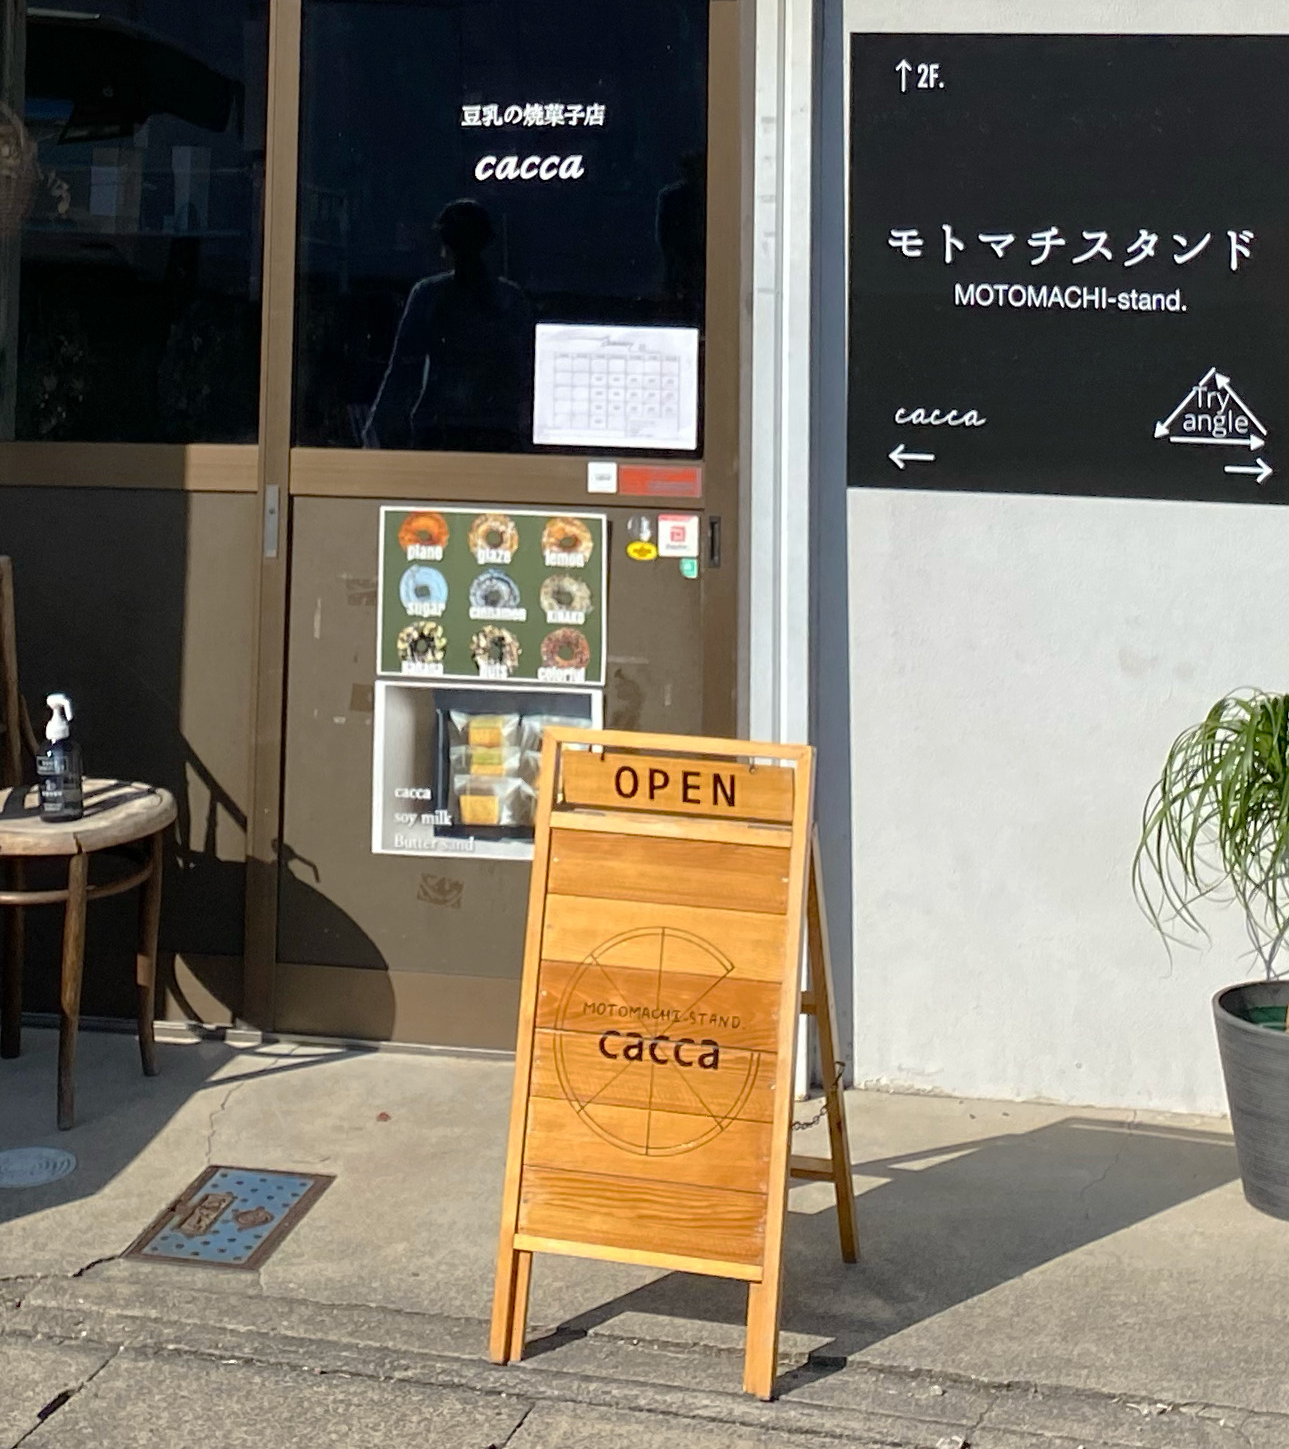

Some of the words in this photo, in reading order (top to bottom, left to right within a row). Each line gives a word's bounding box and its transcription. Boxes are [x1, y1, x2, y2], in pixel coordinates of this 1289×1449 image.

[461, 102, 607, 127] 豆乳の焼菓子店
[474, 154, 585, 181] cacca
[887, 223, 1255, 272] モトマチスタンド
[953, 283, 1188, 313] MOTOMACHI-stand.
[1192, 385, 1230, 414] Try
[894, 406, 987, 428] cacca
[1182, 407, 1250, 438] angle
[394, 787, 432, 800] cacca
[614, 765, 737, 808] OPEN
[394, 814, 418, 828] soy
[421, 809, 453, 827] milk
[394, 833, 437, 850] Butter
[441, 836, 475, 852] sand
[598, 1029, 720, 1071] cacca
